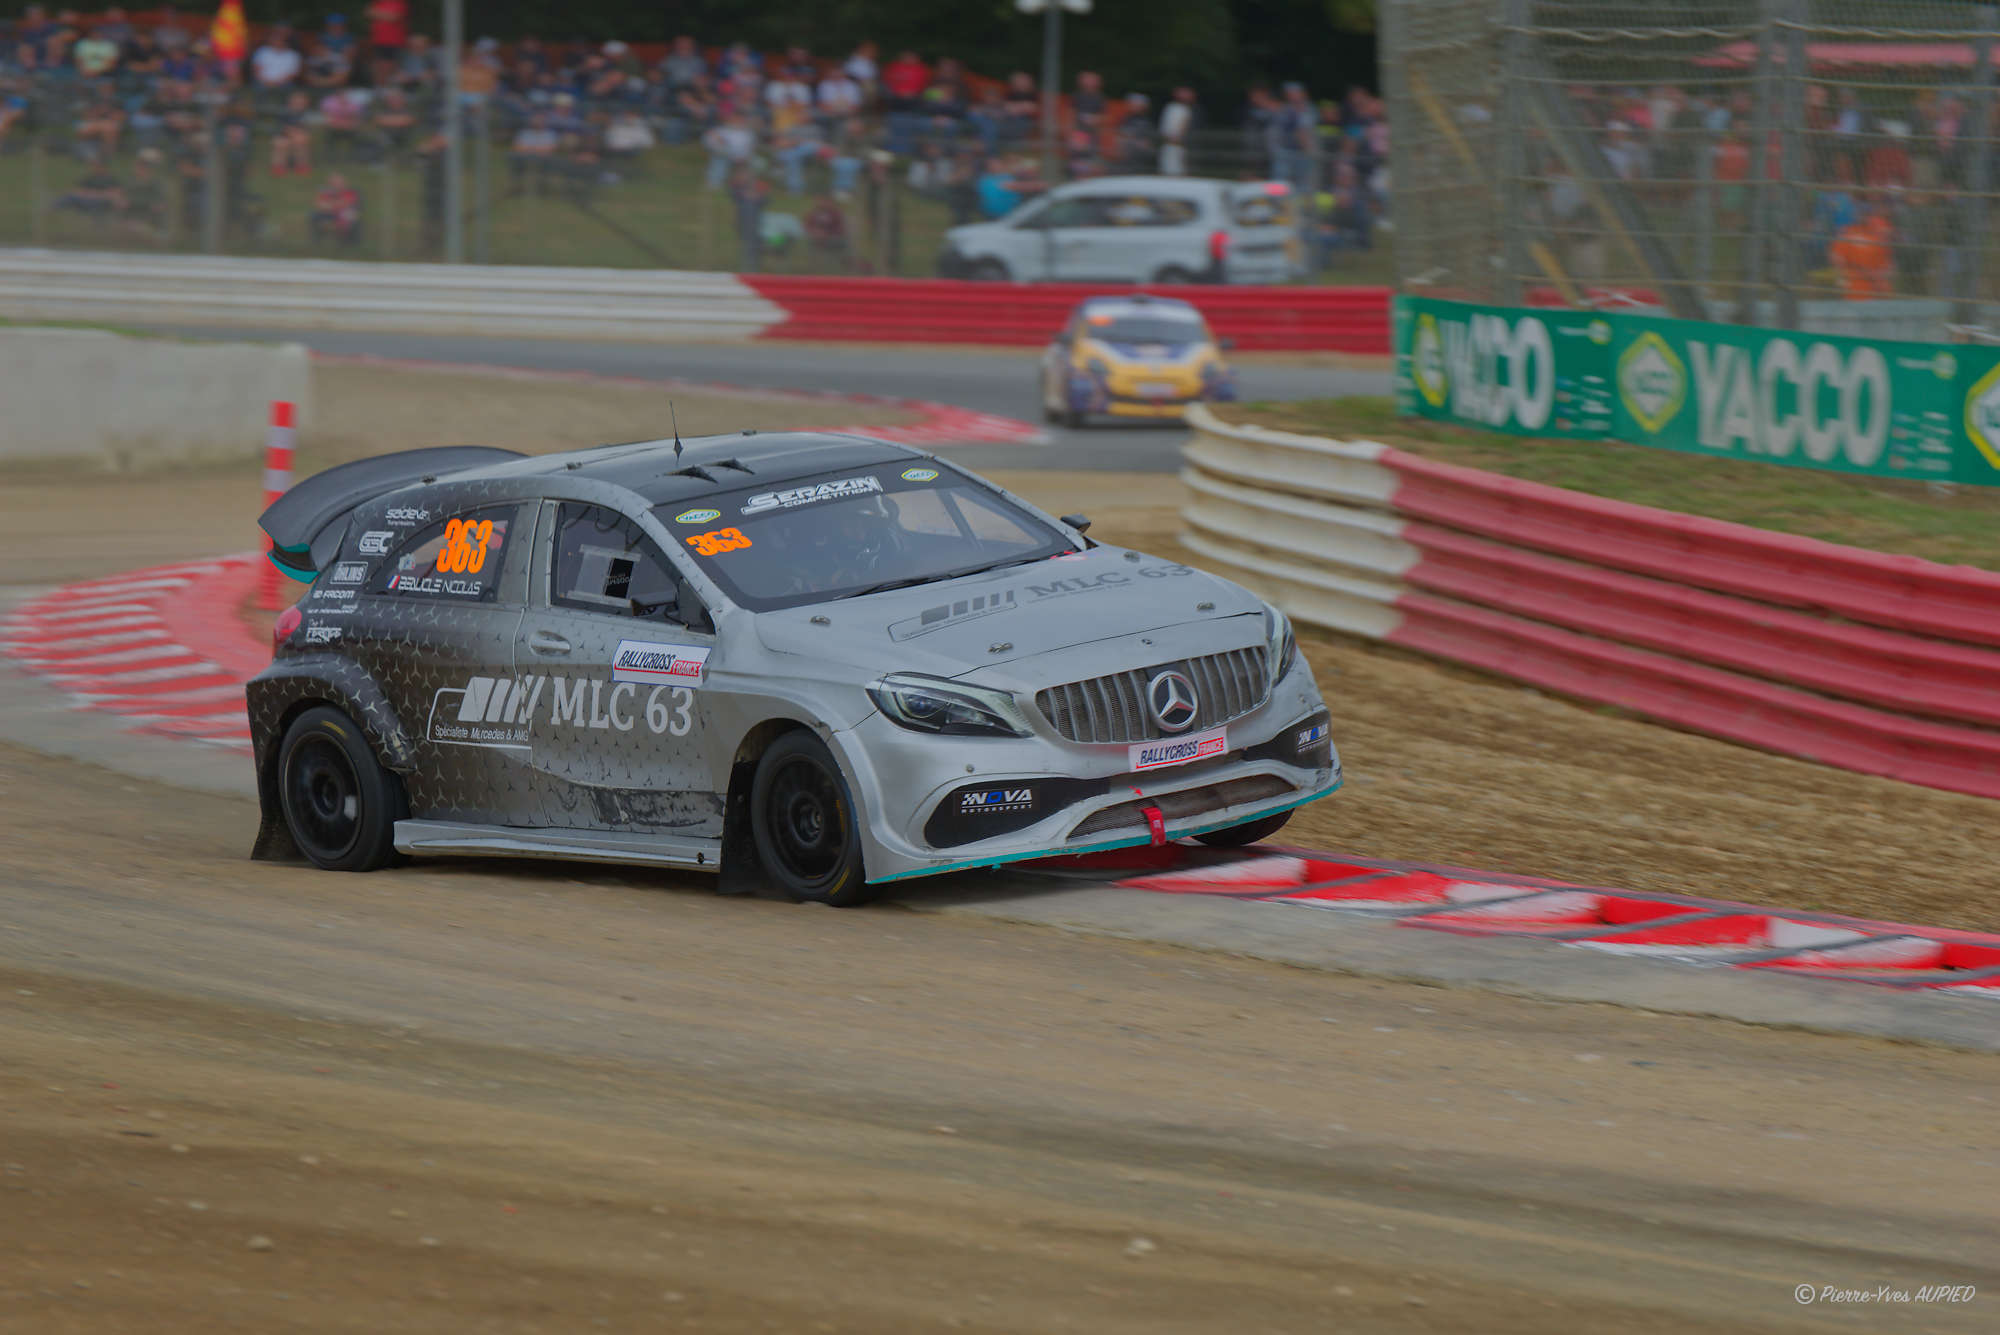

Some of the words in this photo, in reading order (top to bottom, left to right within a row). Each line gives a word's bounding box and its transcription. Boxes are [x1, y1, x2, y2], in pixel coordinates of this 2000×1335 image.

[1686, 338, 1892, 468] YACCO
[743, 476, 883, 513] SERAZIN
[783, 487, 875, 508] COMPETITION
[436, 518, 493, 574] 363
[686, 527, 752, 557] 363
[1024, 571, 1131, 598] MLC
[1138, 565, 1194, 579] 63
[617, 650, 676, 671] RALLYCROSS
[671, 661, 700, 676] FRANCE
[551, 676, 636, 732] MLC
[646, 685, 694, 737] 63
[1140, 741, 1199, 764] RALLYCROSS
